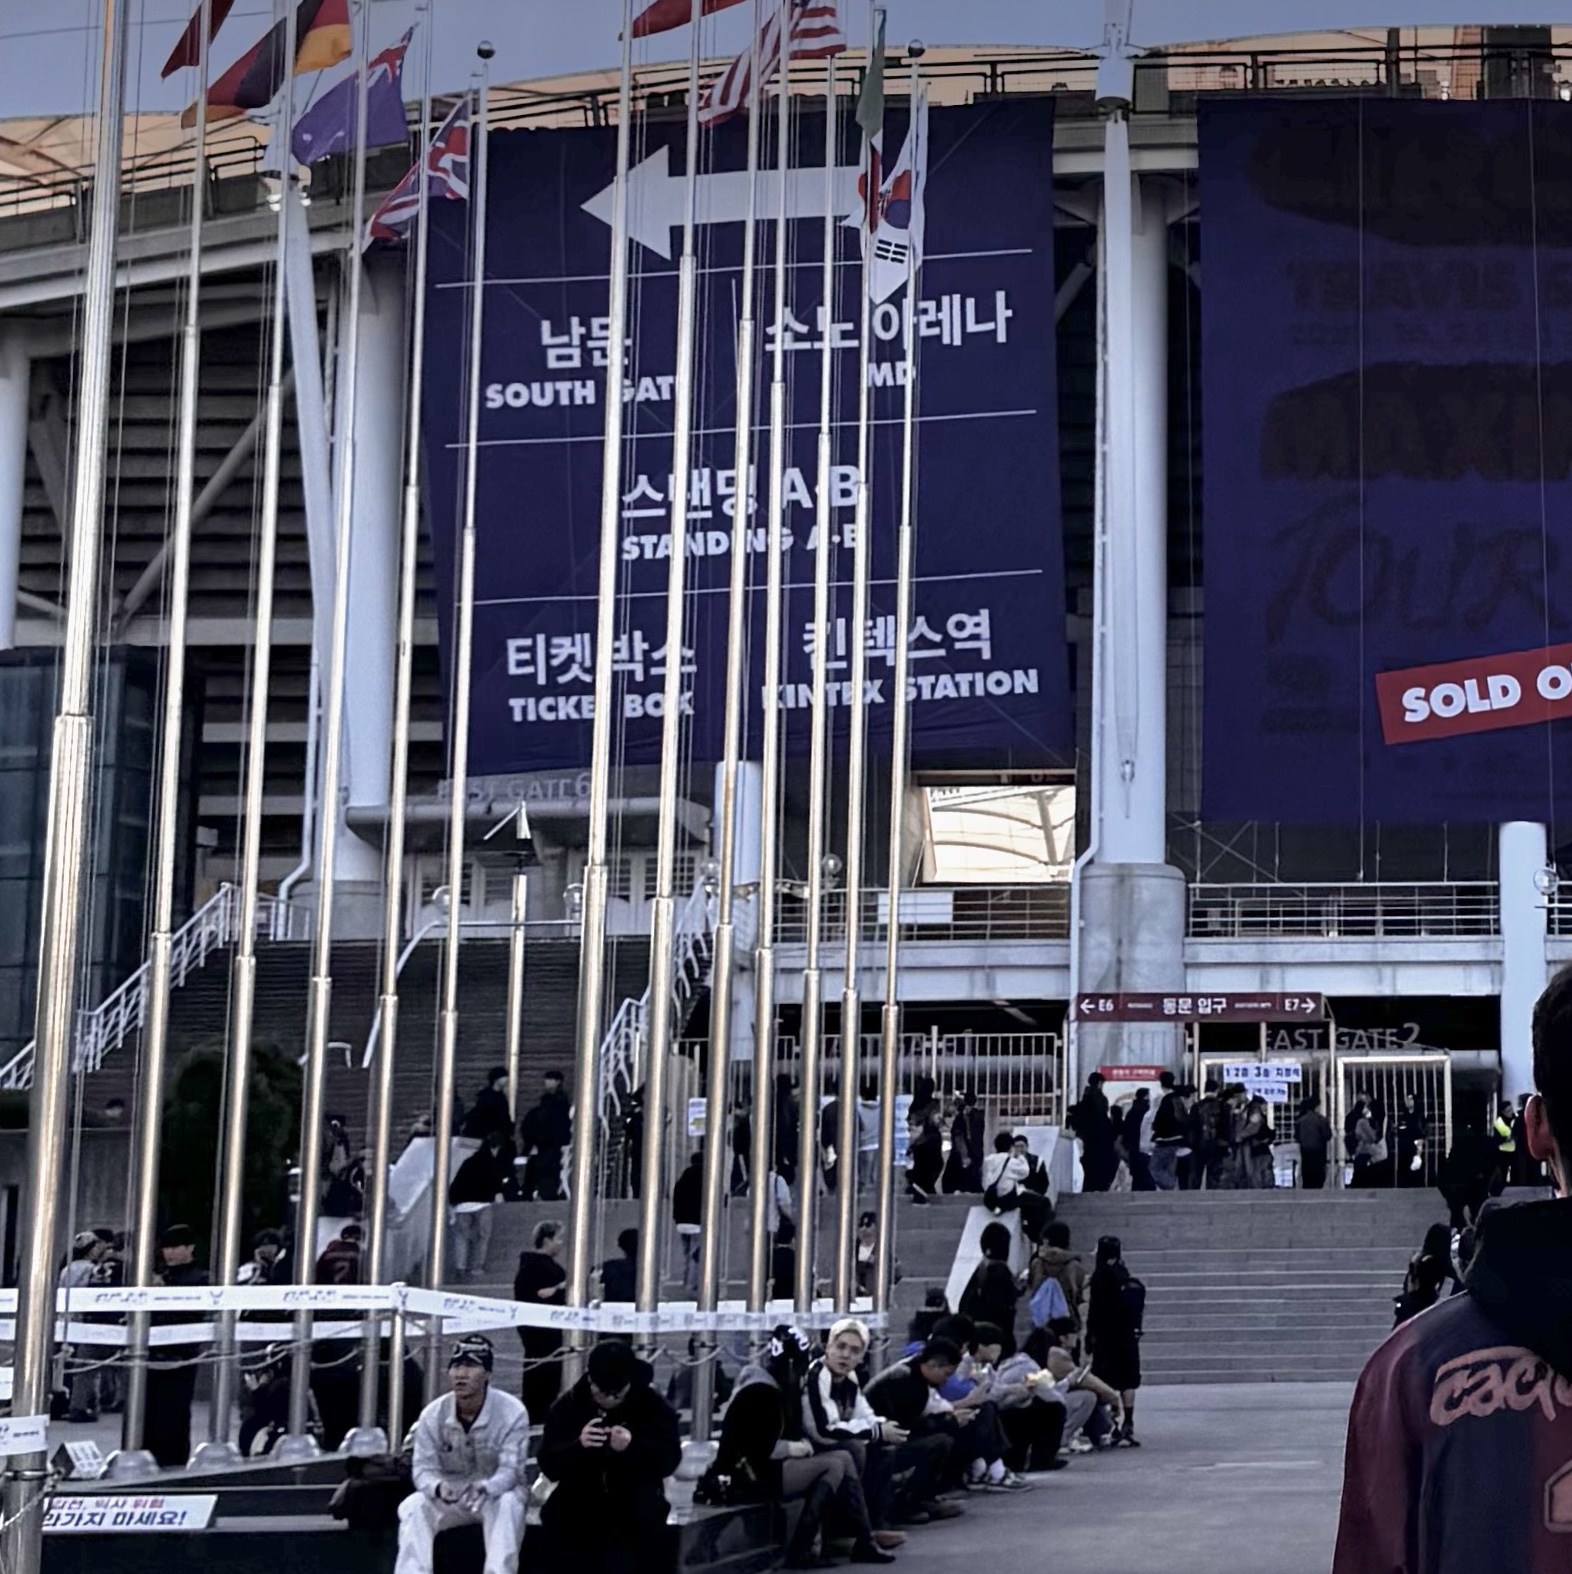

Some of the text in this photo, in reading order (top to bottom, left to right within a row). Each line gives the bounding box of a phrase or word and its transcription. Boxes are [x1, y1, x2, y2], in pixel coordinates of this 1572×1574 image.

[1285, 260, 1519, 311] TRAVIS
[871, 288, 1013, 348] 아레나
[541, 316, 632, 369] 남문
[867, 361, 917, 387] MD
[485, 380, 596, 409] SOUTH
[621, 530, 794, 560] STANDNG
[803, 608, 991, 670] 킨텍스역
[507, 630, 698, 686] 티켓 박스
[905, 669, 1039, 701] STATION
[1401, 672, 1521, 723] SOLD
[508, 694, 596, 723] TICKE
[575, 772, 590, 797] 6
[1098, 998, 1299, 1015] E6 동문 입구 E7
[1335, 1028, 1399, 1051] GATE
[1402, 1022, 1421, 1050] 2
[112, 1511, 187, 1526] 마세요!
